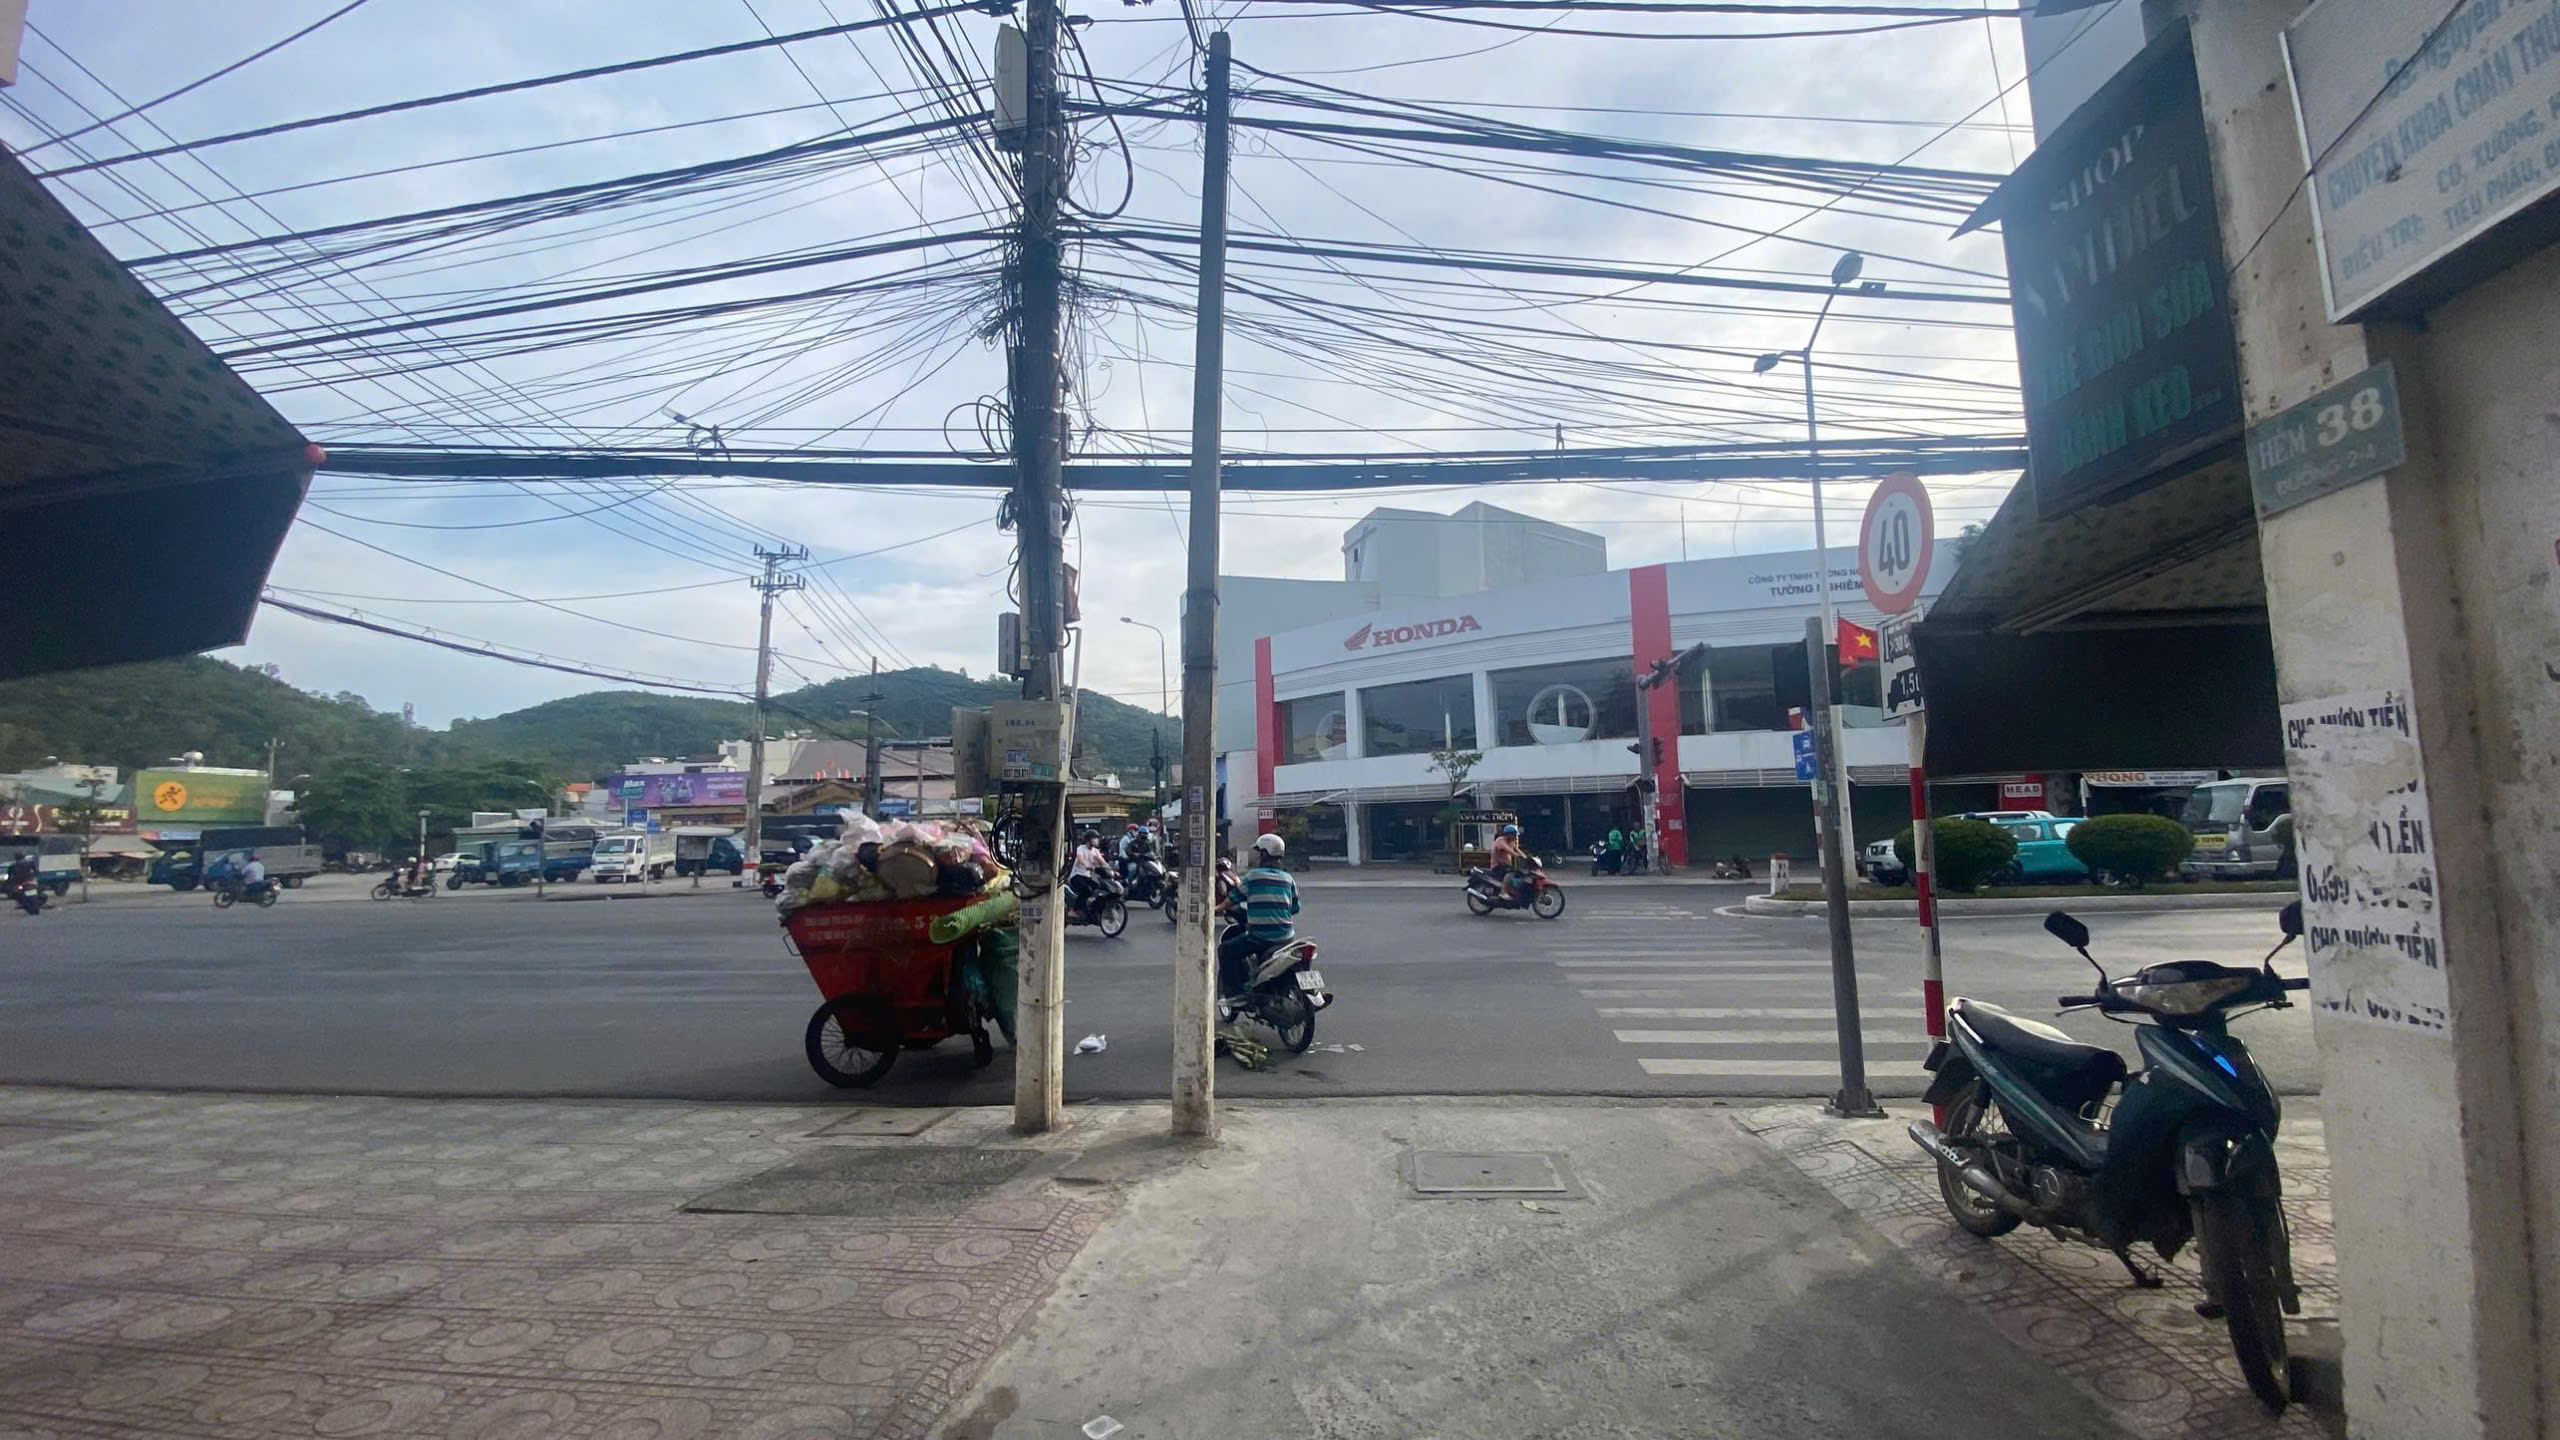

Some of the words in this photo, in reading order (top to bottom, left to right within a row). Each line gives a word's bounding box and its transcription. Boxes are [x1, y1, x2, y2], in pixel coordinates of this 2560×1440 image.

[2397, 91, 2453, 160] KHOA
[2050, 124, 2144, 224] SHOP
[2316, 387, 2385, 447] 38
[1879, 508, 1910, 577] 40
[1748, 573, 1774, 585] CÔNG
[1776, 573, 1786, 583] TY
[1770, 583, 1814, 597] TƯỜNG
[1372, 614, 1482, 648] HONDA
[2006, 784, 2042, 796] HEAD
